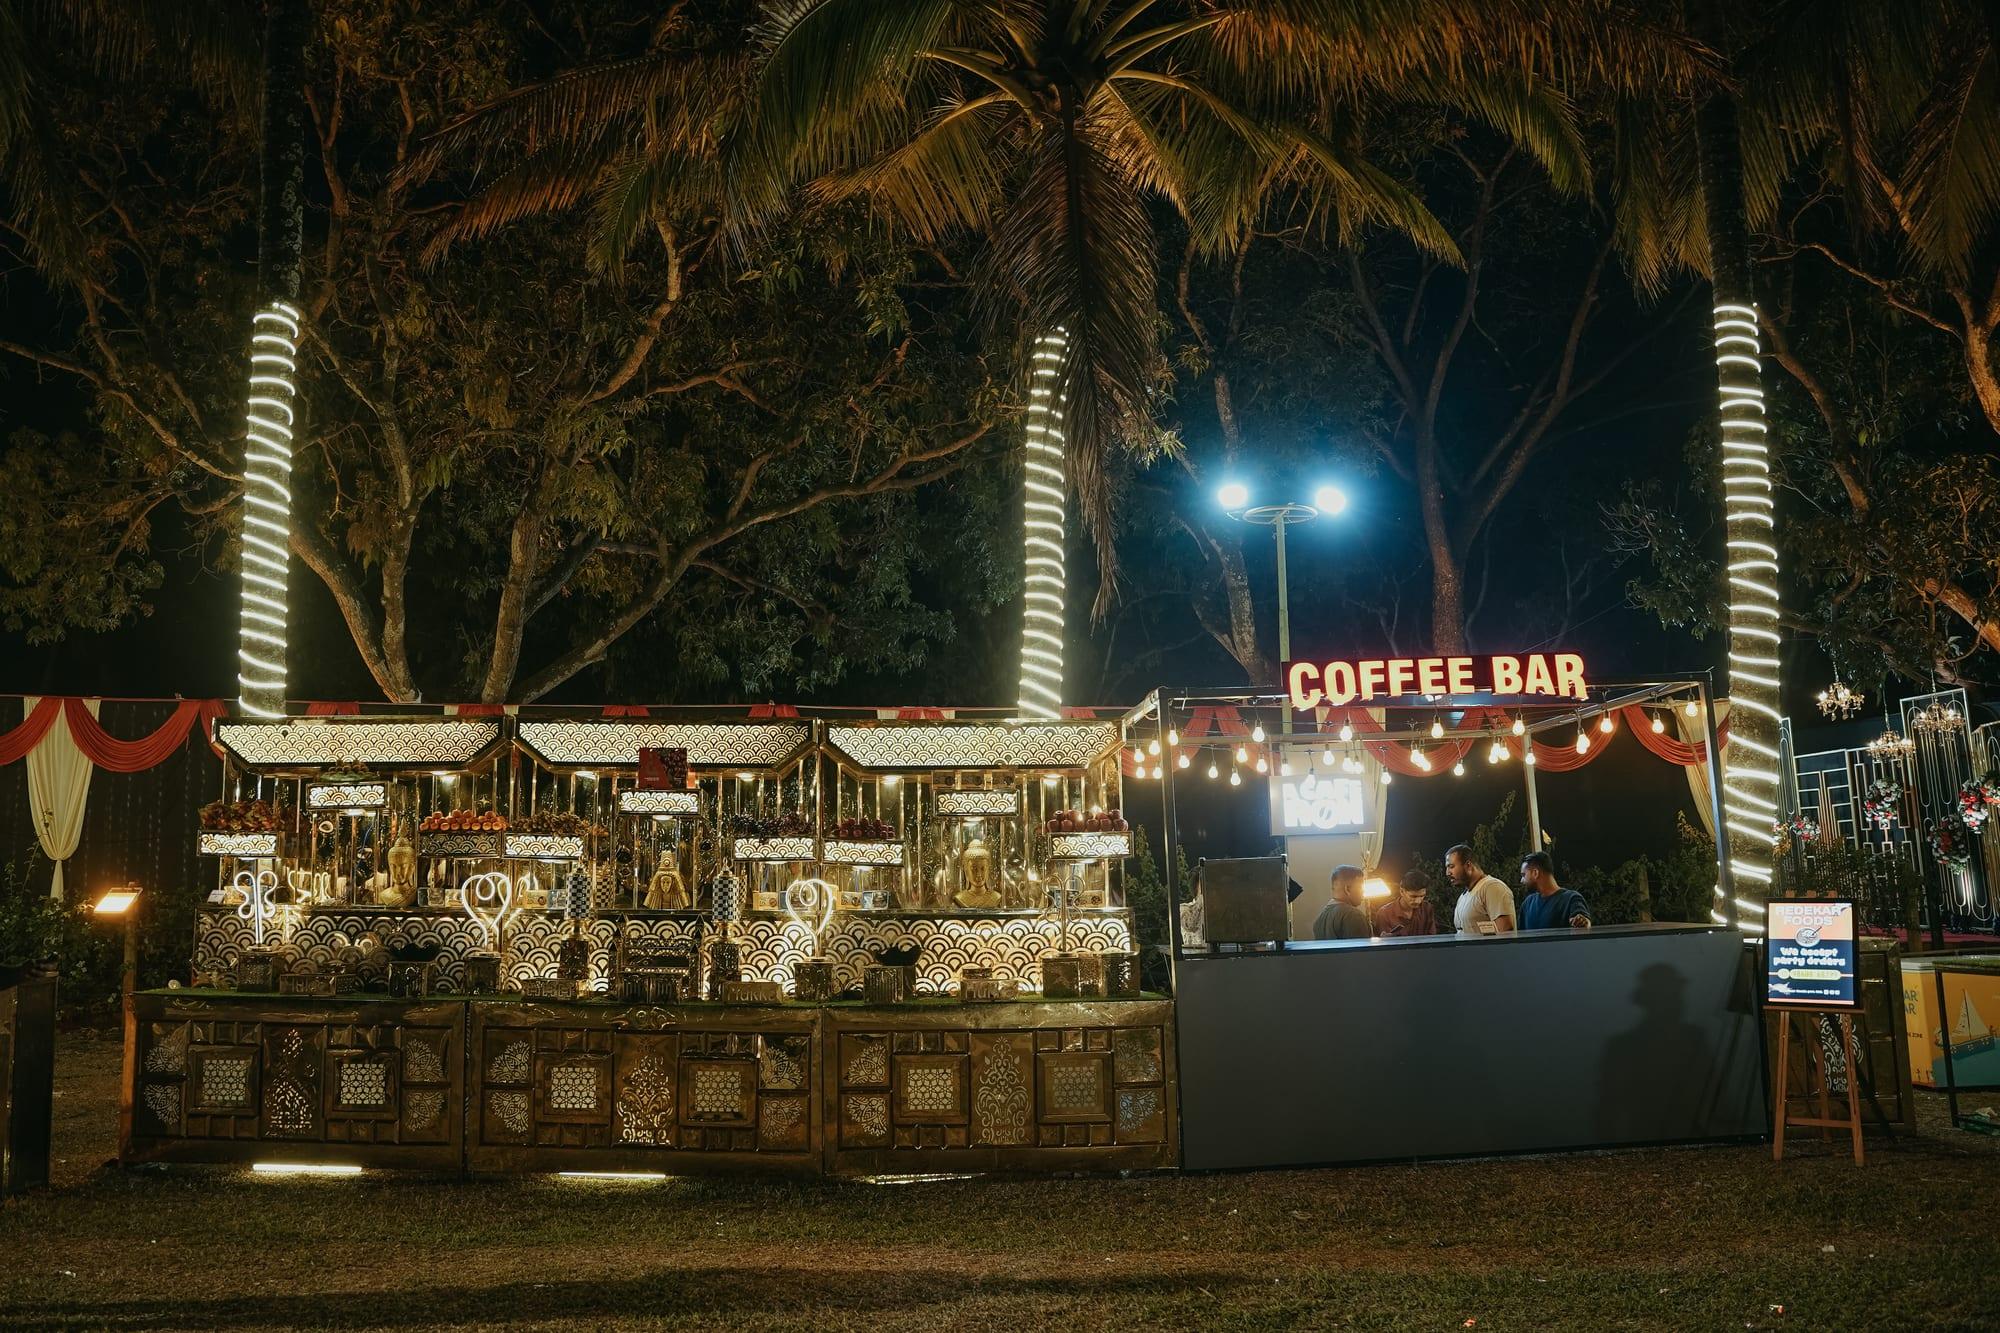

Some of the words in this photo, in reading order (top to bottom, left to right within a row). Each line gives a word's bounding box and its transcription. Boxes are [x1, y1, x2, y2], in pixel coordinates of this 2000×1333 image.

[1288, 656, 1475, 711] COFFEE
[1491, 653, 1589, 701] BAR
[1784, 916, 1833, 926] FOODS
[1780, 947, 1799, 956] We
[1773, 957, 1806, 966] party
[1904, 990, 1919, 1002] AR
